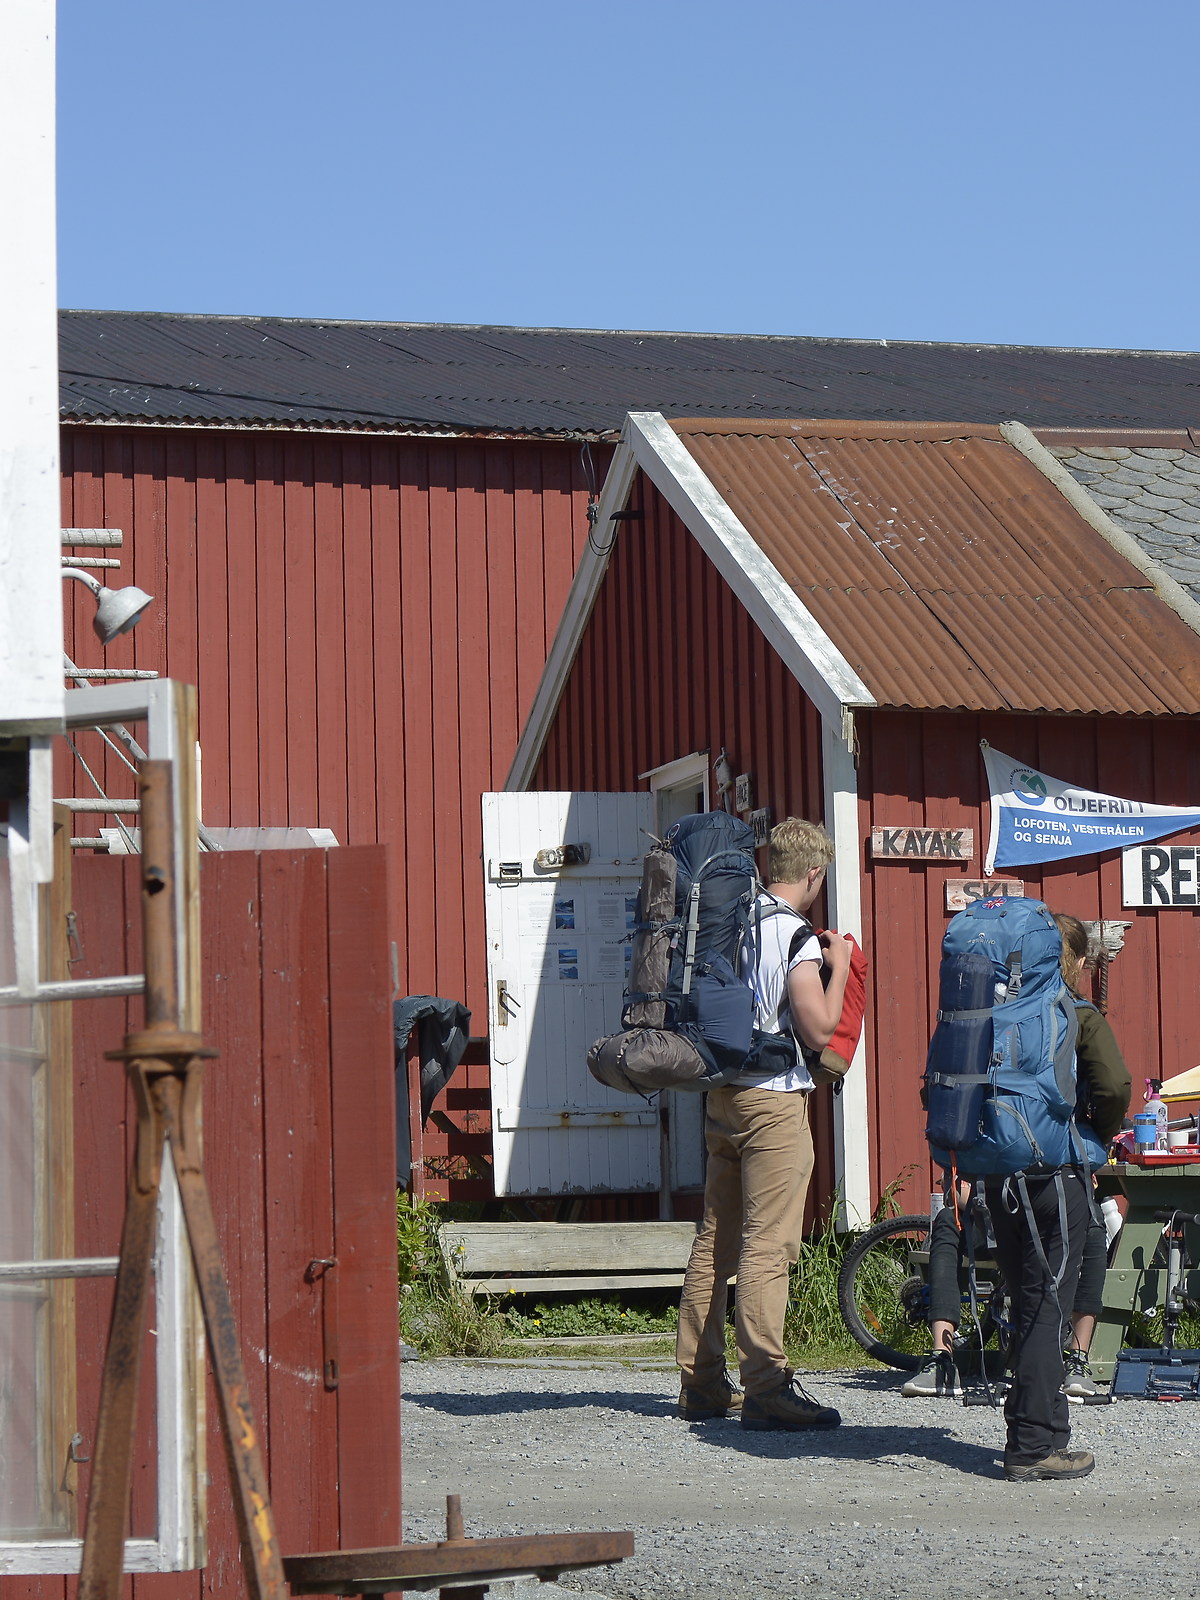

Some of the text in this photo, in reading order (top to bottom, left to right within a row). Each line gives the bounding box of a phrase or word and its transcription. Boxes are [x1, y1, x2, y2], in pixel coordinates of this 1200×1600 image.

[1014, 817, 1144, 836] LOFOTEN, VESTERÅLEN
[882, 829, 964, 858] KAYAK
[1013, 831, 1073, 846] OG SENJA
